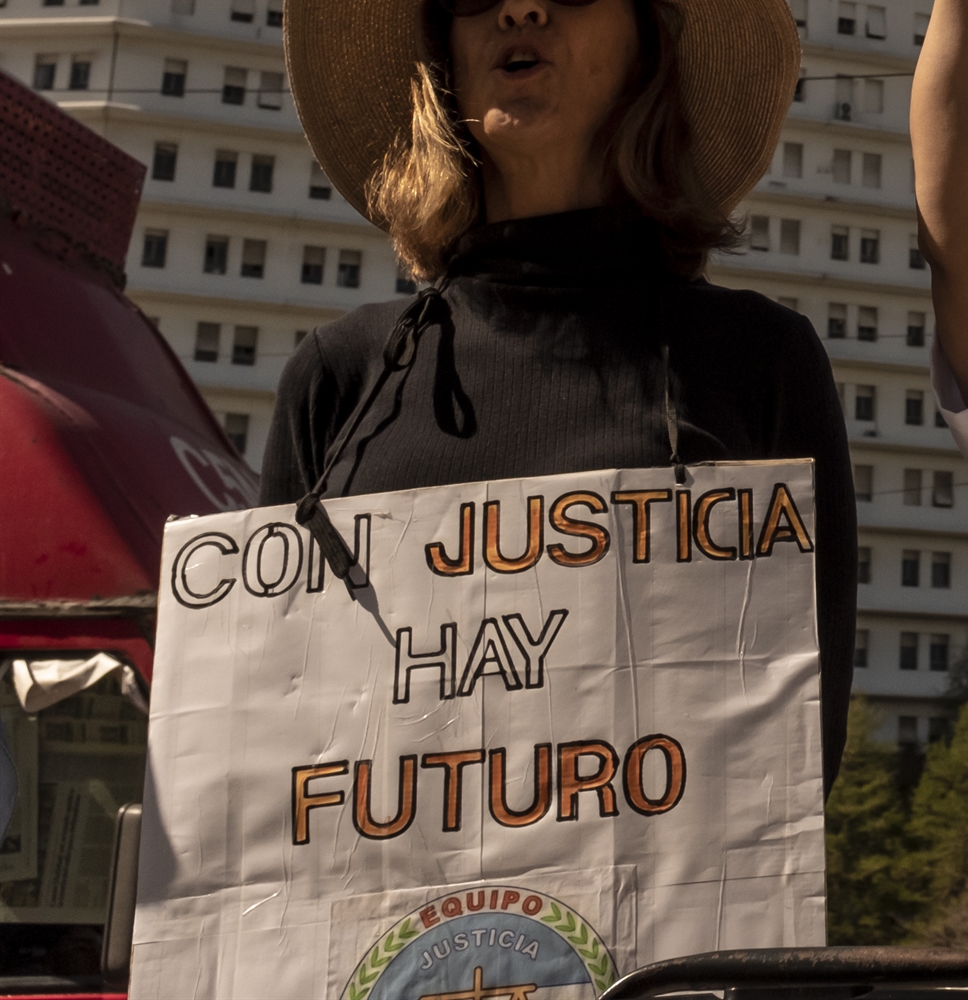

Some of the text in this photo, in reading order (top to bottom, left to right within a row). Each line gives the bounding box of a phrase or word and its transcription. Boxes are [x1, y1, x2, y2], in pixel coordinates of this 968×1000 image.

[170, 482, 816, 610] CON JUSTICIA
[391, 608, 570, 705] HAY
[290, 733, 688, 846] FUTURO
[418, 889, 544, 929] EQUIPO
[419, 927, 541, 971] JUSTICIA
